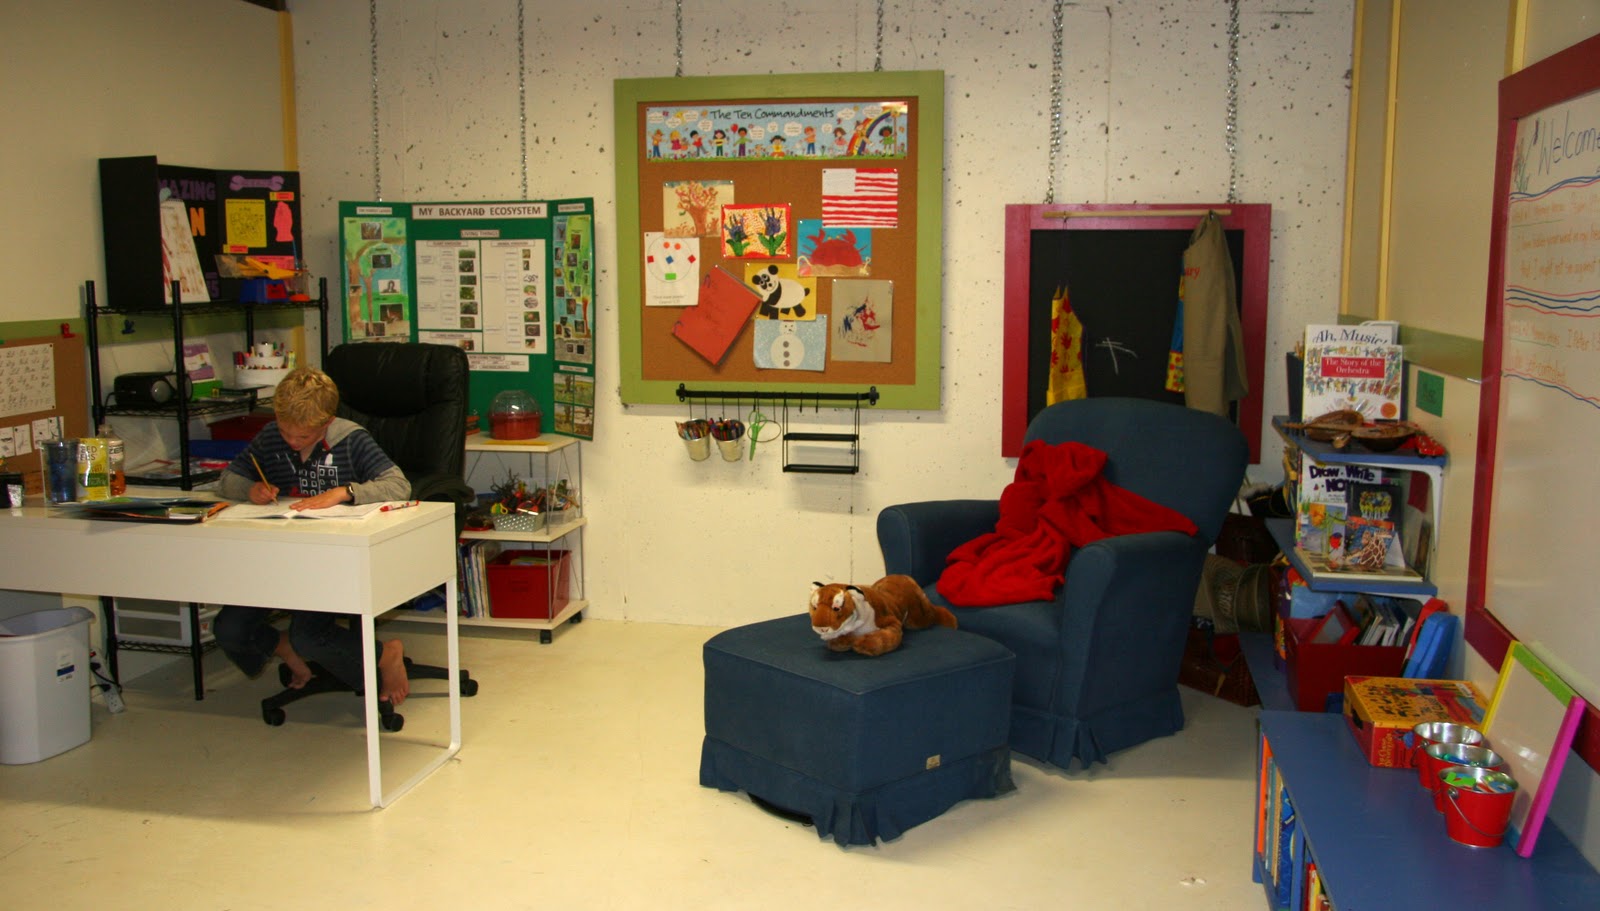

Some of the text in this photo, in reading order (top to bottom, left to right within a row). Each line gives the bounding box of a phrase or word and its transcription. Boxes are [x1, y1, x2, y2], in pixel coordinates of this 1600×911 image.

[710, 107, 835, 120] The Ten Commandments
[418, 206, 542, 217] MY BACKYARD ECOSYSTEM
[1312, 329, 1337, 343] Ah,
[1325, 358, 1382, 367] The Story of the
[1335, 366, 1370, 375] Orchestra
[1309, 465, 1375, 482] Draw Write
[1325, 478, 1360, 493] NO
